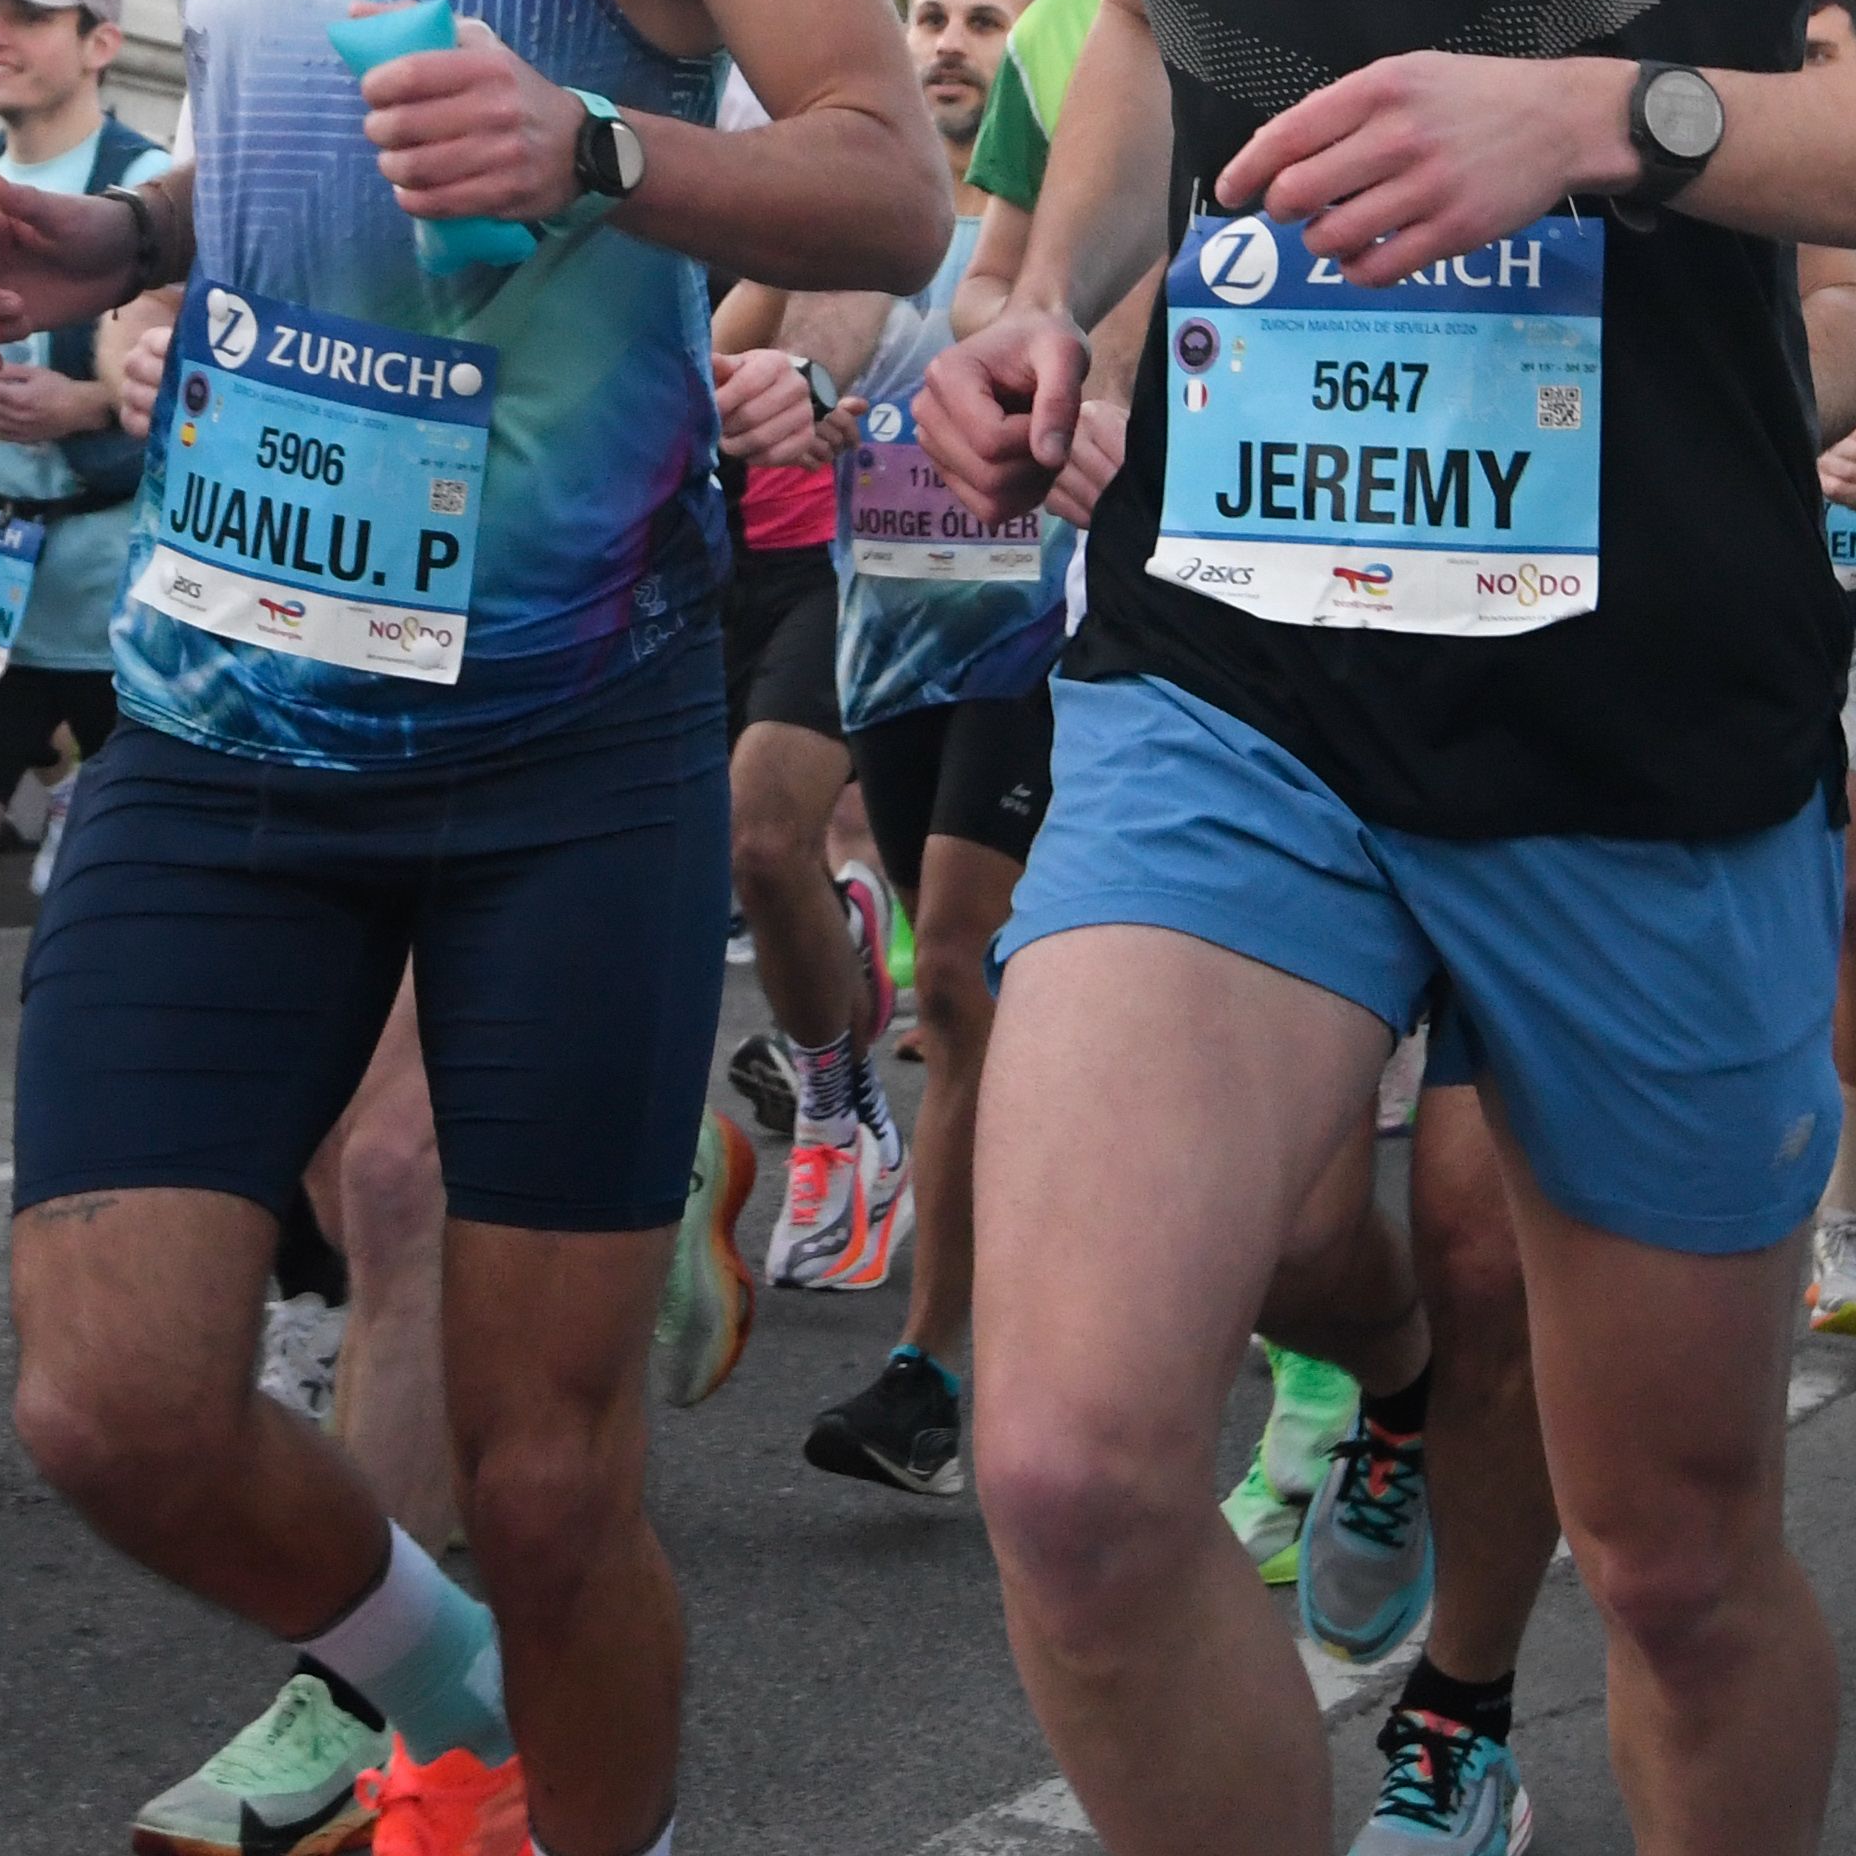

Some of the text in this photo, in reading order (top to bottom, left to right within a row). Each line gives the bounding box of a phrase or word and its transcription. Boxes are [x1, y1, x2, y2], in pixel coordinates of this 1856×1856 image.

[266, 325, 447, 400] ZURICH
[1311, 360, 1430, 413] 5647
[256, 426, 346, 486] 5906
[1215, 440, 1532, 531] JEREMY
[170, 472, 460, 593] JUANLU. P
[854, 507, 932, 537] JORGE
[1200, 563, 1255, 586] asics
